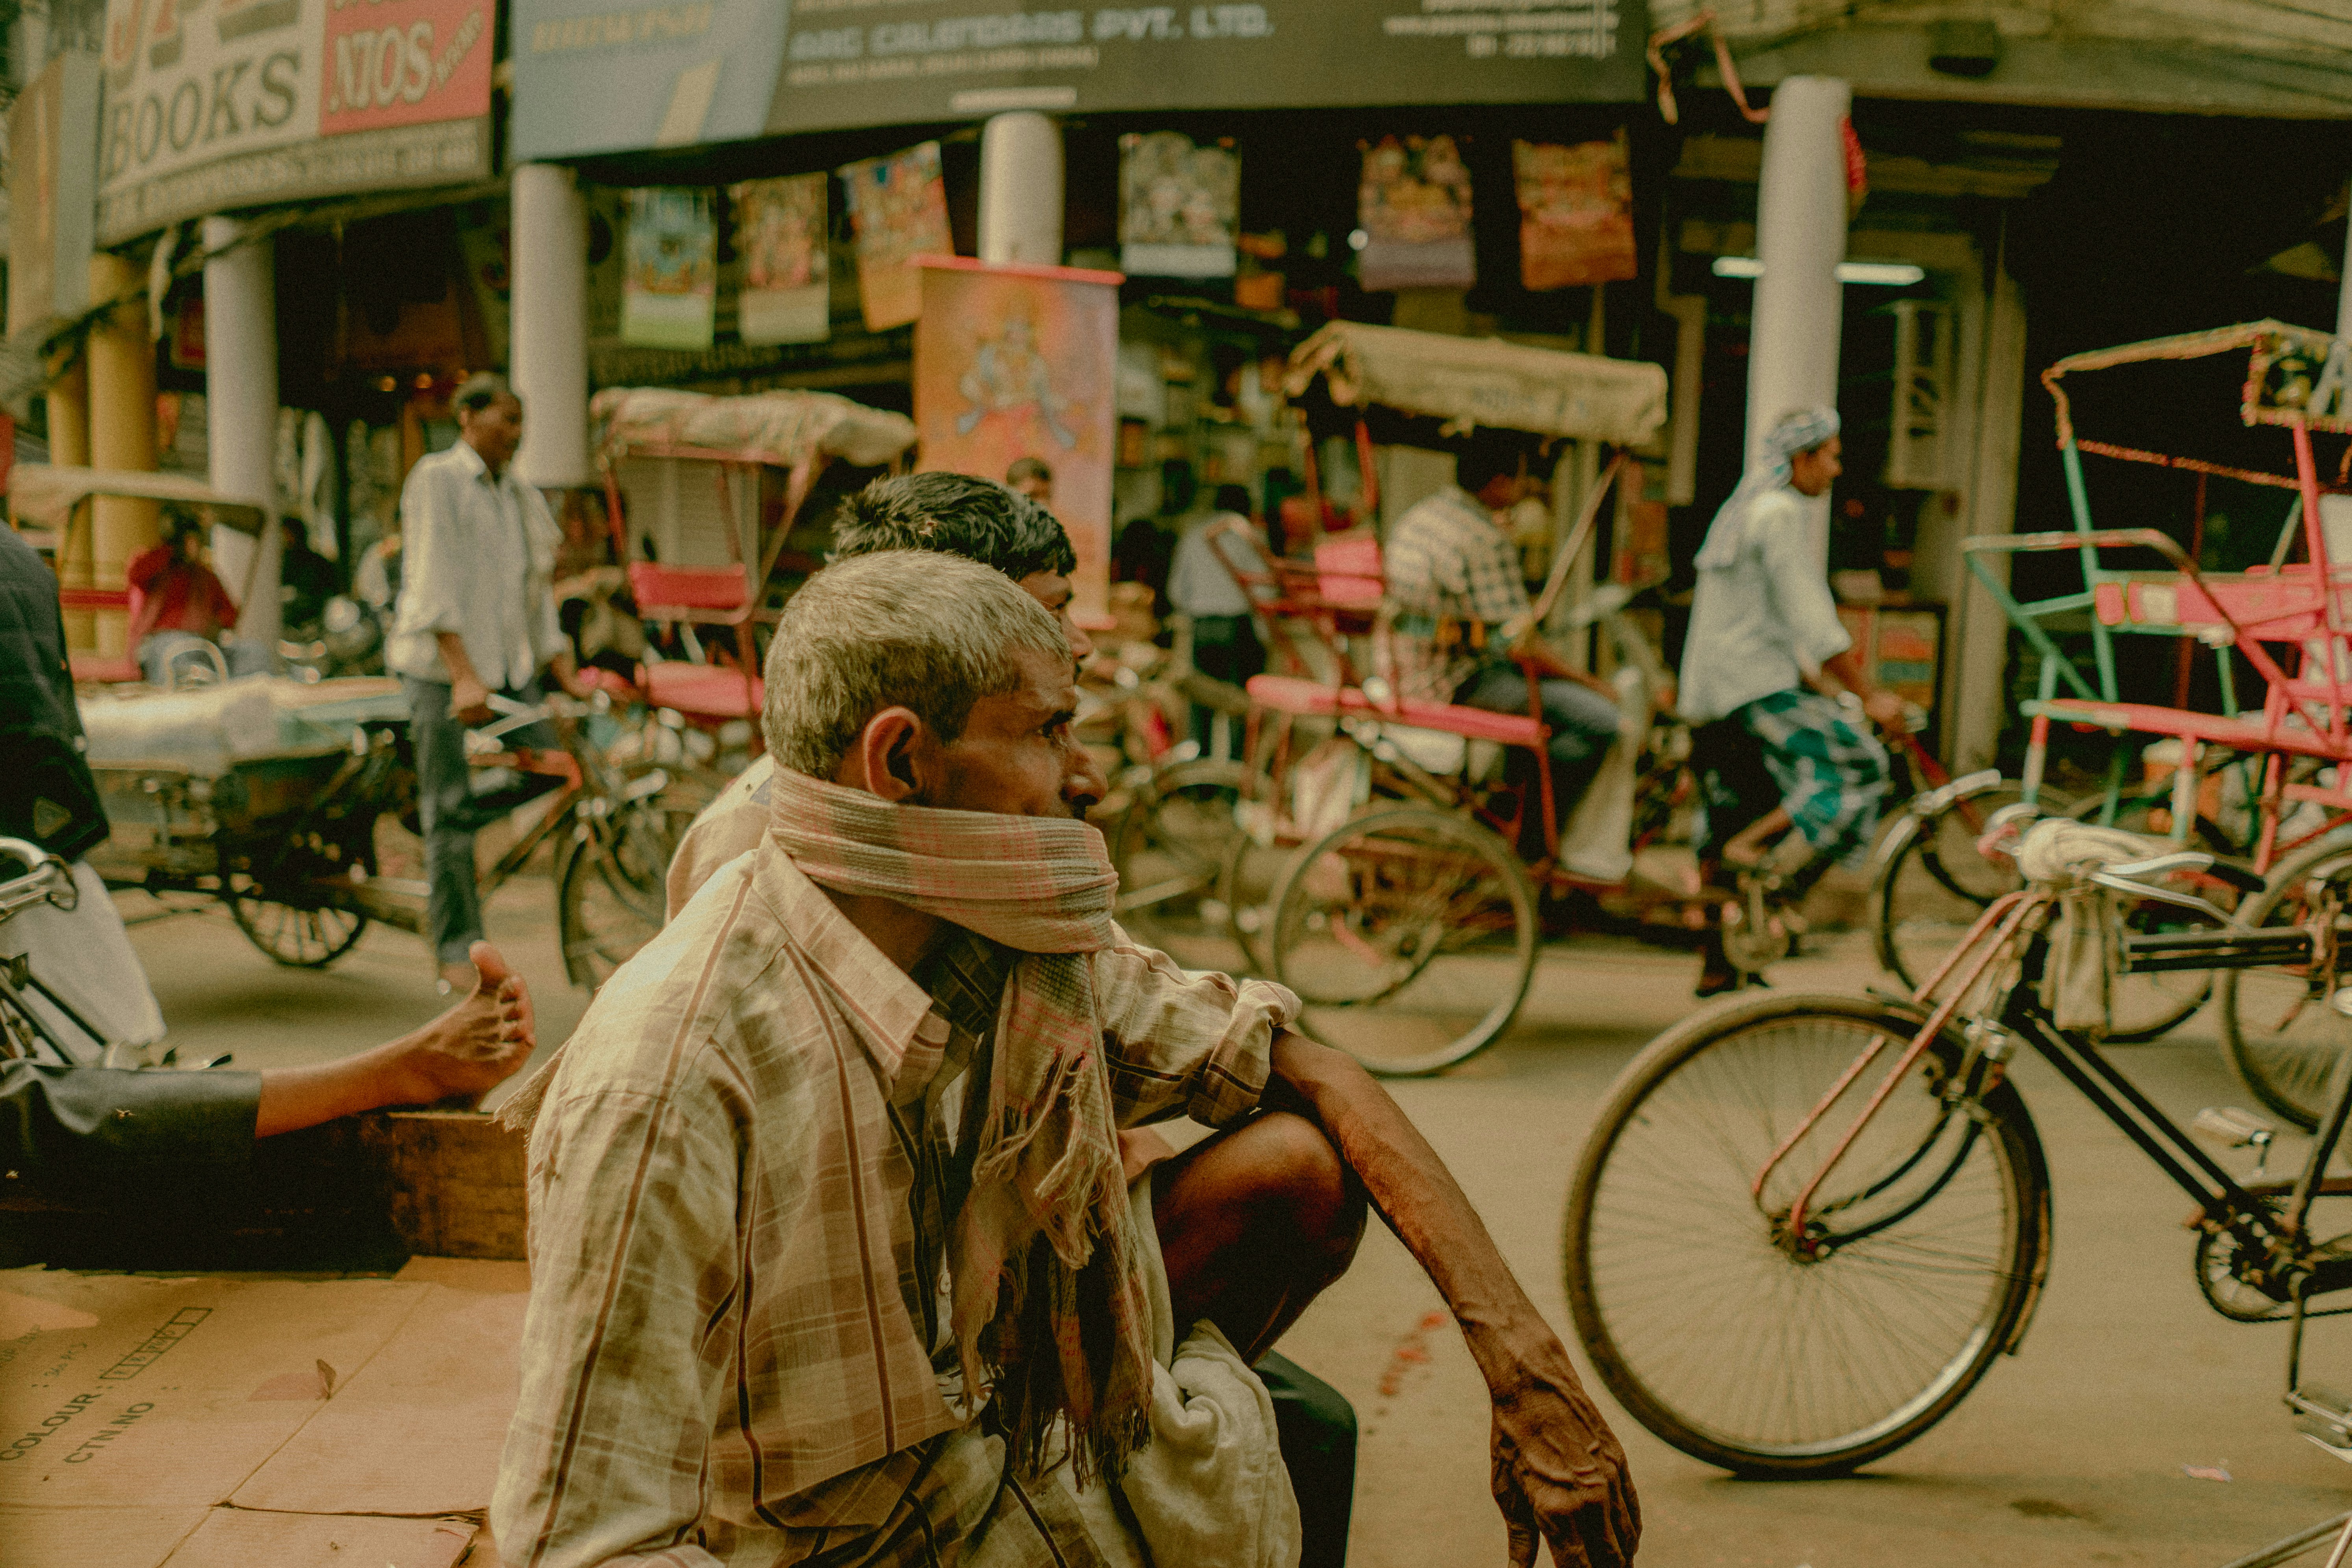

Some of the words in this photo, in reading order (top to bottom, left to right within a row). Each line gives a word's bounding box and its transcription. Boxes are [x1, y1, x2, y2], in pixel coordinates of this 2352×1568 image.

[1091, 6, 1184, 41] PVT.
[1189, 3, 1276, 38] LTD.
[107, 50, 302, 186] BOOKS
[0, 1392, 102, 1462] COLOUR
